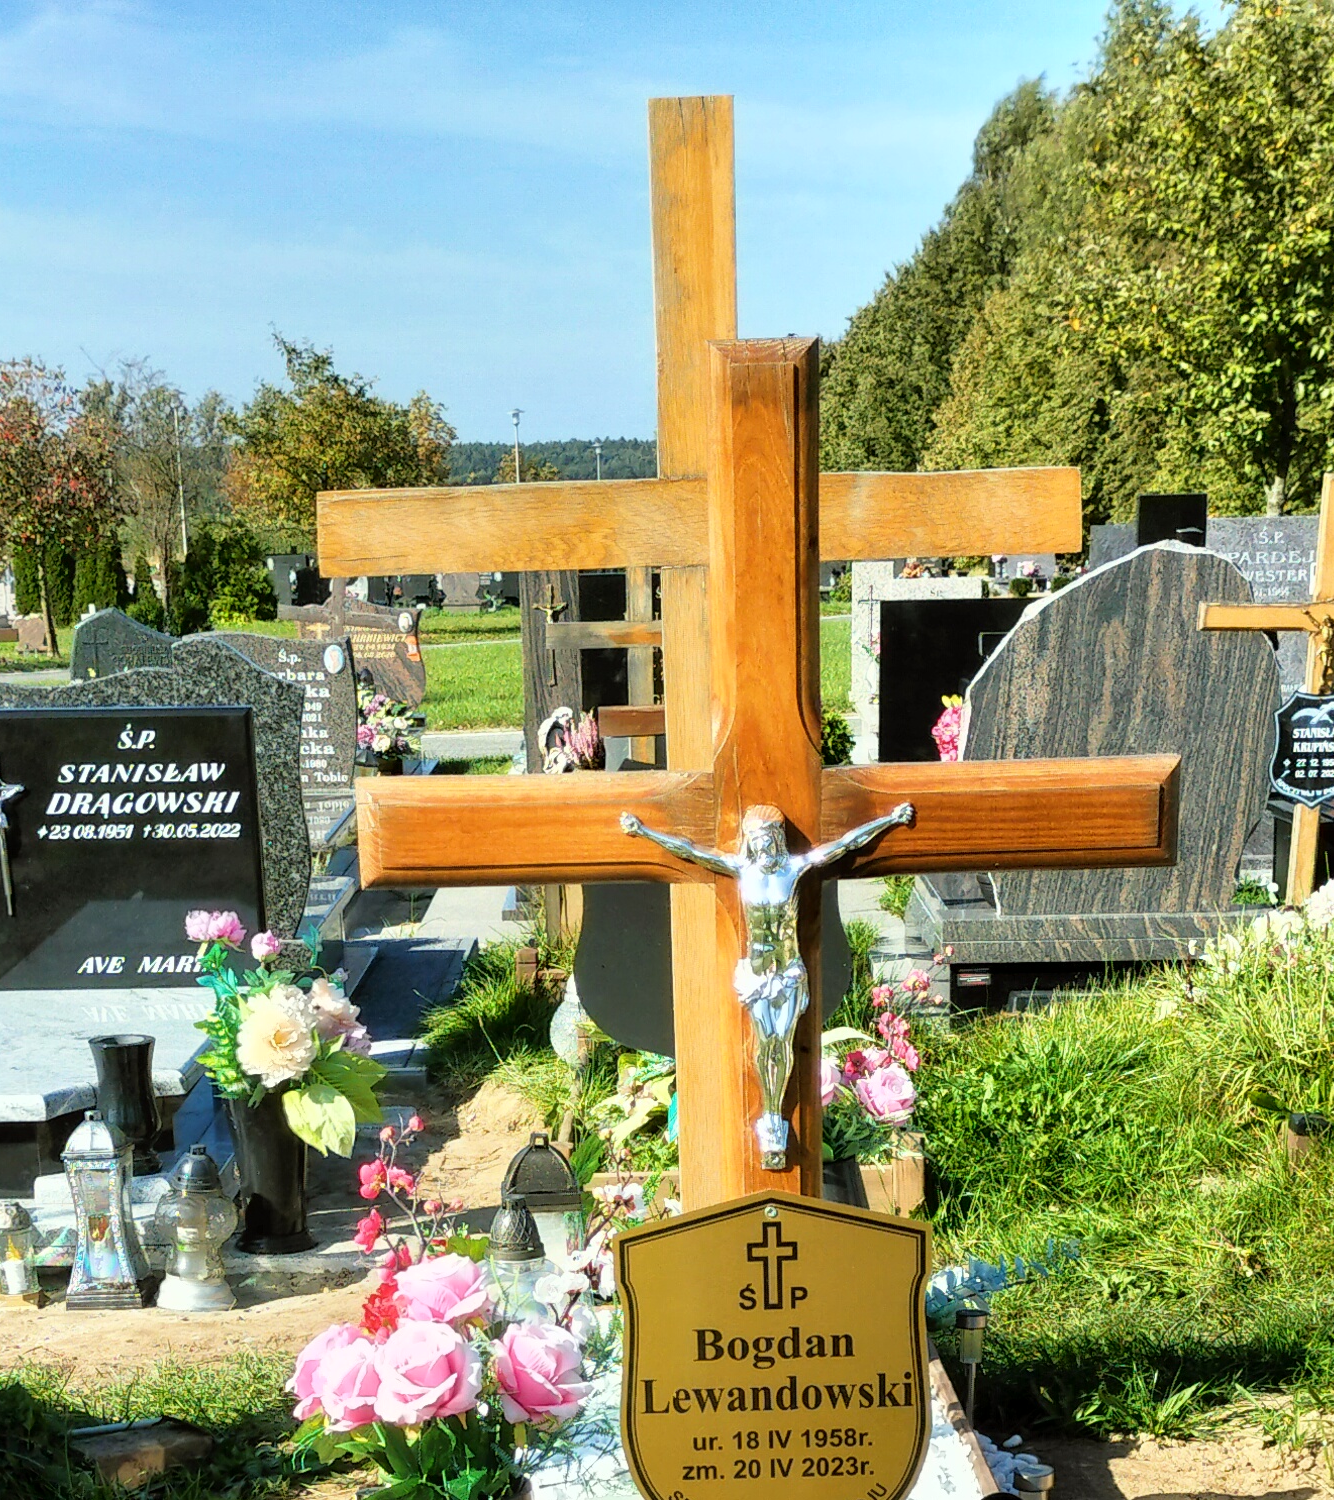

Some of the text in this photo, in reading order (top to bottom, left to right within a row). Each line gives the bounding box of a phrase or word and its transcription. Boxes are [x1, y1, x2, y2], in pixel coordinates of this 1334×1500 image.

[278, 648, 301, 665] Ś.p.
[117, 724, 156, 750] Ś.P.
[58, 763, 226, 783] STANISŁAW
[45, 791, 241, 818] DRĄGOWSKI
[151, 823, 242, 839] 30.05.2022
[77, 956, 125, 974] AVE
[693, 1326, 855, 1369] Bogdan
[641, 1371, 915, 1414] Lewandowski
[692, 1428, 873, 1450] ur. 18 IV 1958r.
[682, 1457, 875, 1481] zm. 20 IV 2023r.
